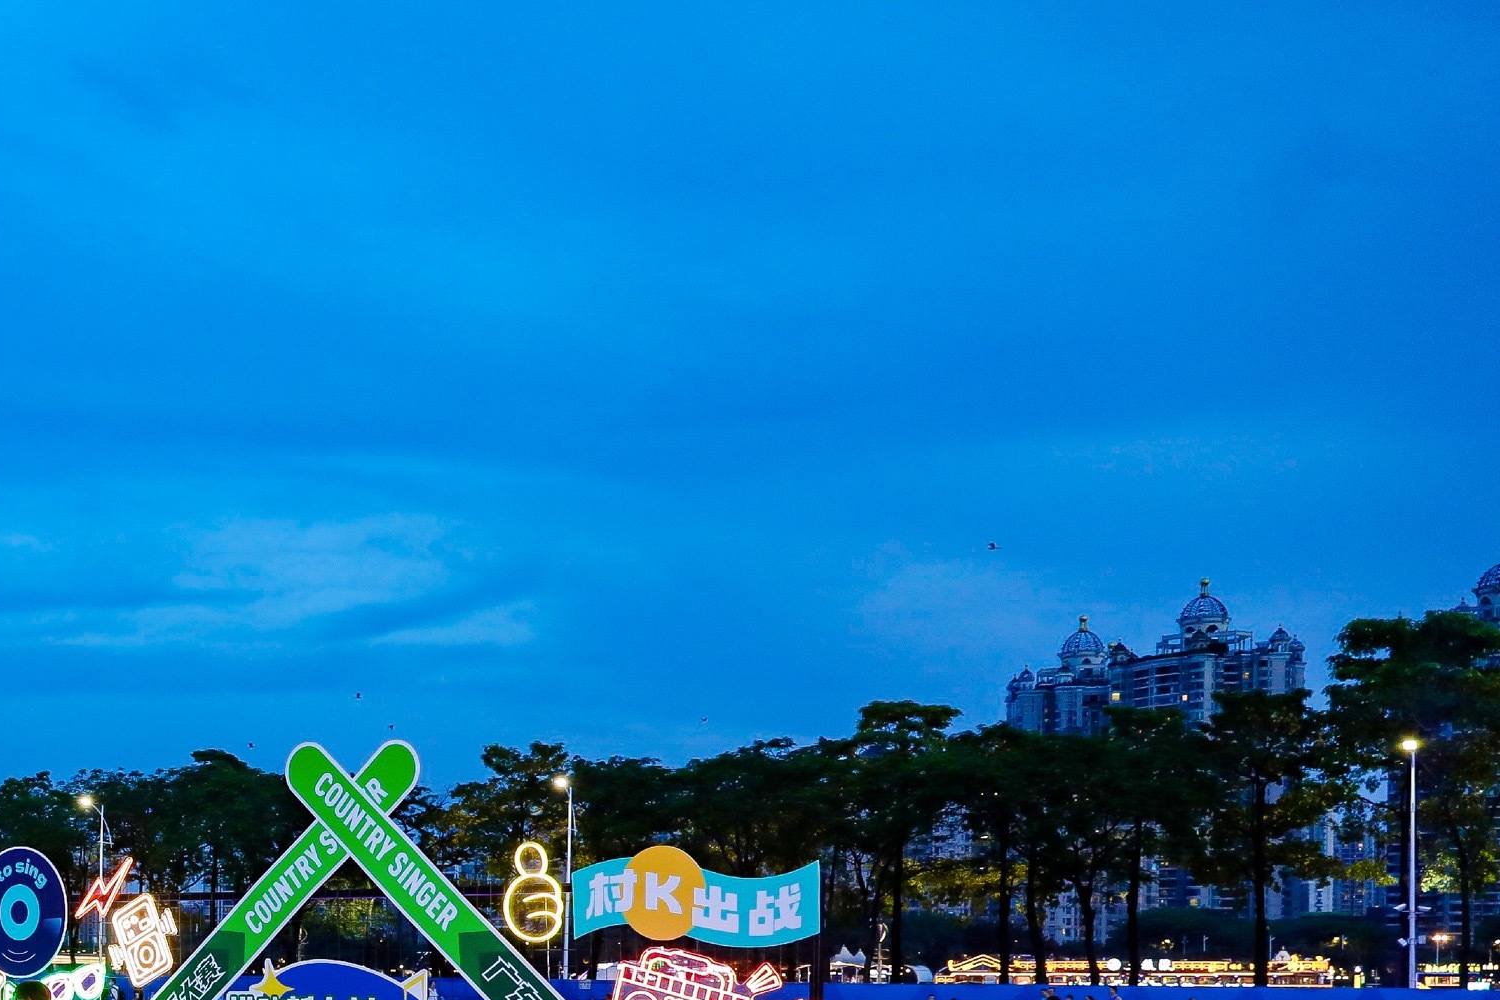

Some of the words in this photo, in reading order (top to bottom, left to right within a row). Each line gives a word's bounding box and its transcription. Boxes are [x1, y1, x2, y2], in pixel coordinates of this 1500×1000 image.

[15, 858, 48, 889] sing
[244, 843, 323, 934] COUNTRY
[314, 772, 397, 861] COUNTRY
[388, 852, 458, 932] SINGER
[585, 868, 802, 936] 村K出战
